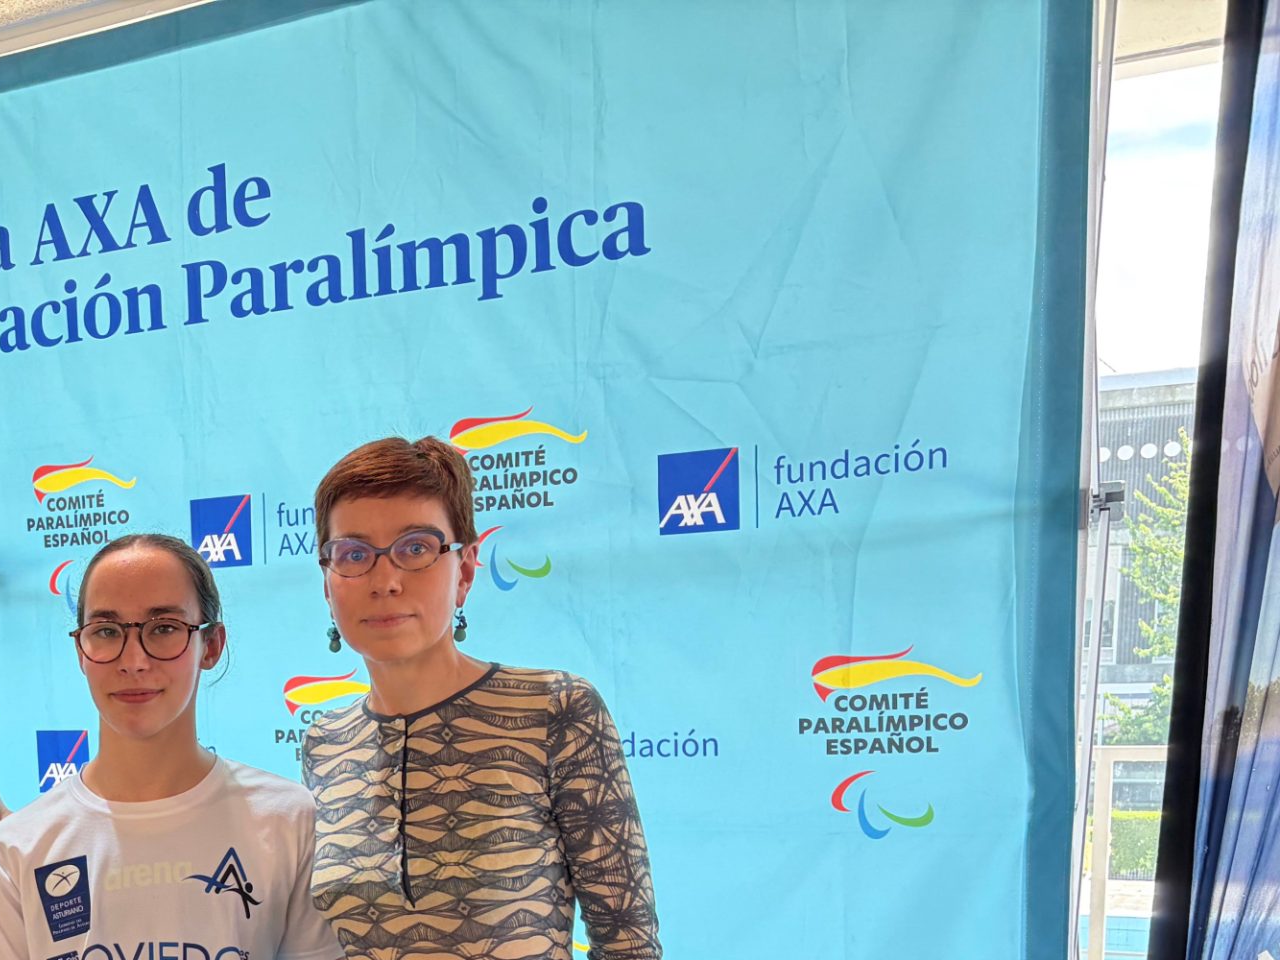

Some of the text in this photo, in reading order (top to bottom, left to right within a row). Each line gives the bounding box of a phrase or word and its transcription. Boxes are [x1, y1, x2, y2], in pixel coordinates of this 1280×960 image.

[30, 184, 171, 265] AXA
[187, 163, 271, 237] de
[181, 196, 652, 327] Paralímpica
[469, 445, 546, 471] COMITÉ
[773, 439, 948, 485] fundación
[47, 490, 104, 512] COMITÉ
[474, 488, 554, 512] SPAÑOL
[660, 491, 726, 528] AXA
[775, 487, 839, 519] AXA
[27, 510, 130, 532] PARALÍMPICO
[43, 527, 111, 548] ESPAÑOL
[194, 533, 242, 562] AXA
[833, 687, 929, 713] COMITÉ
[798, 709, 969, 735] PARALÍMPICO
[622, 729, 719, 758] dación
[825, 731, 939, 756] ESPAÑOL
